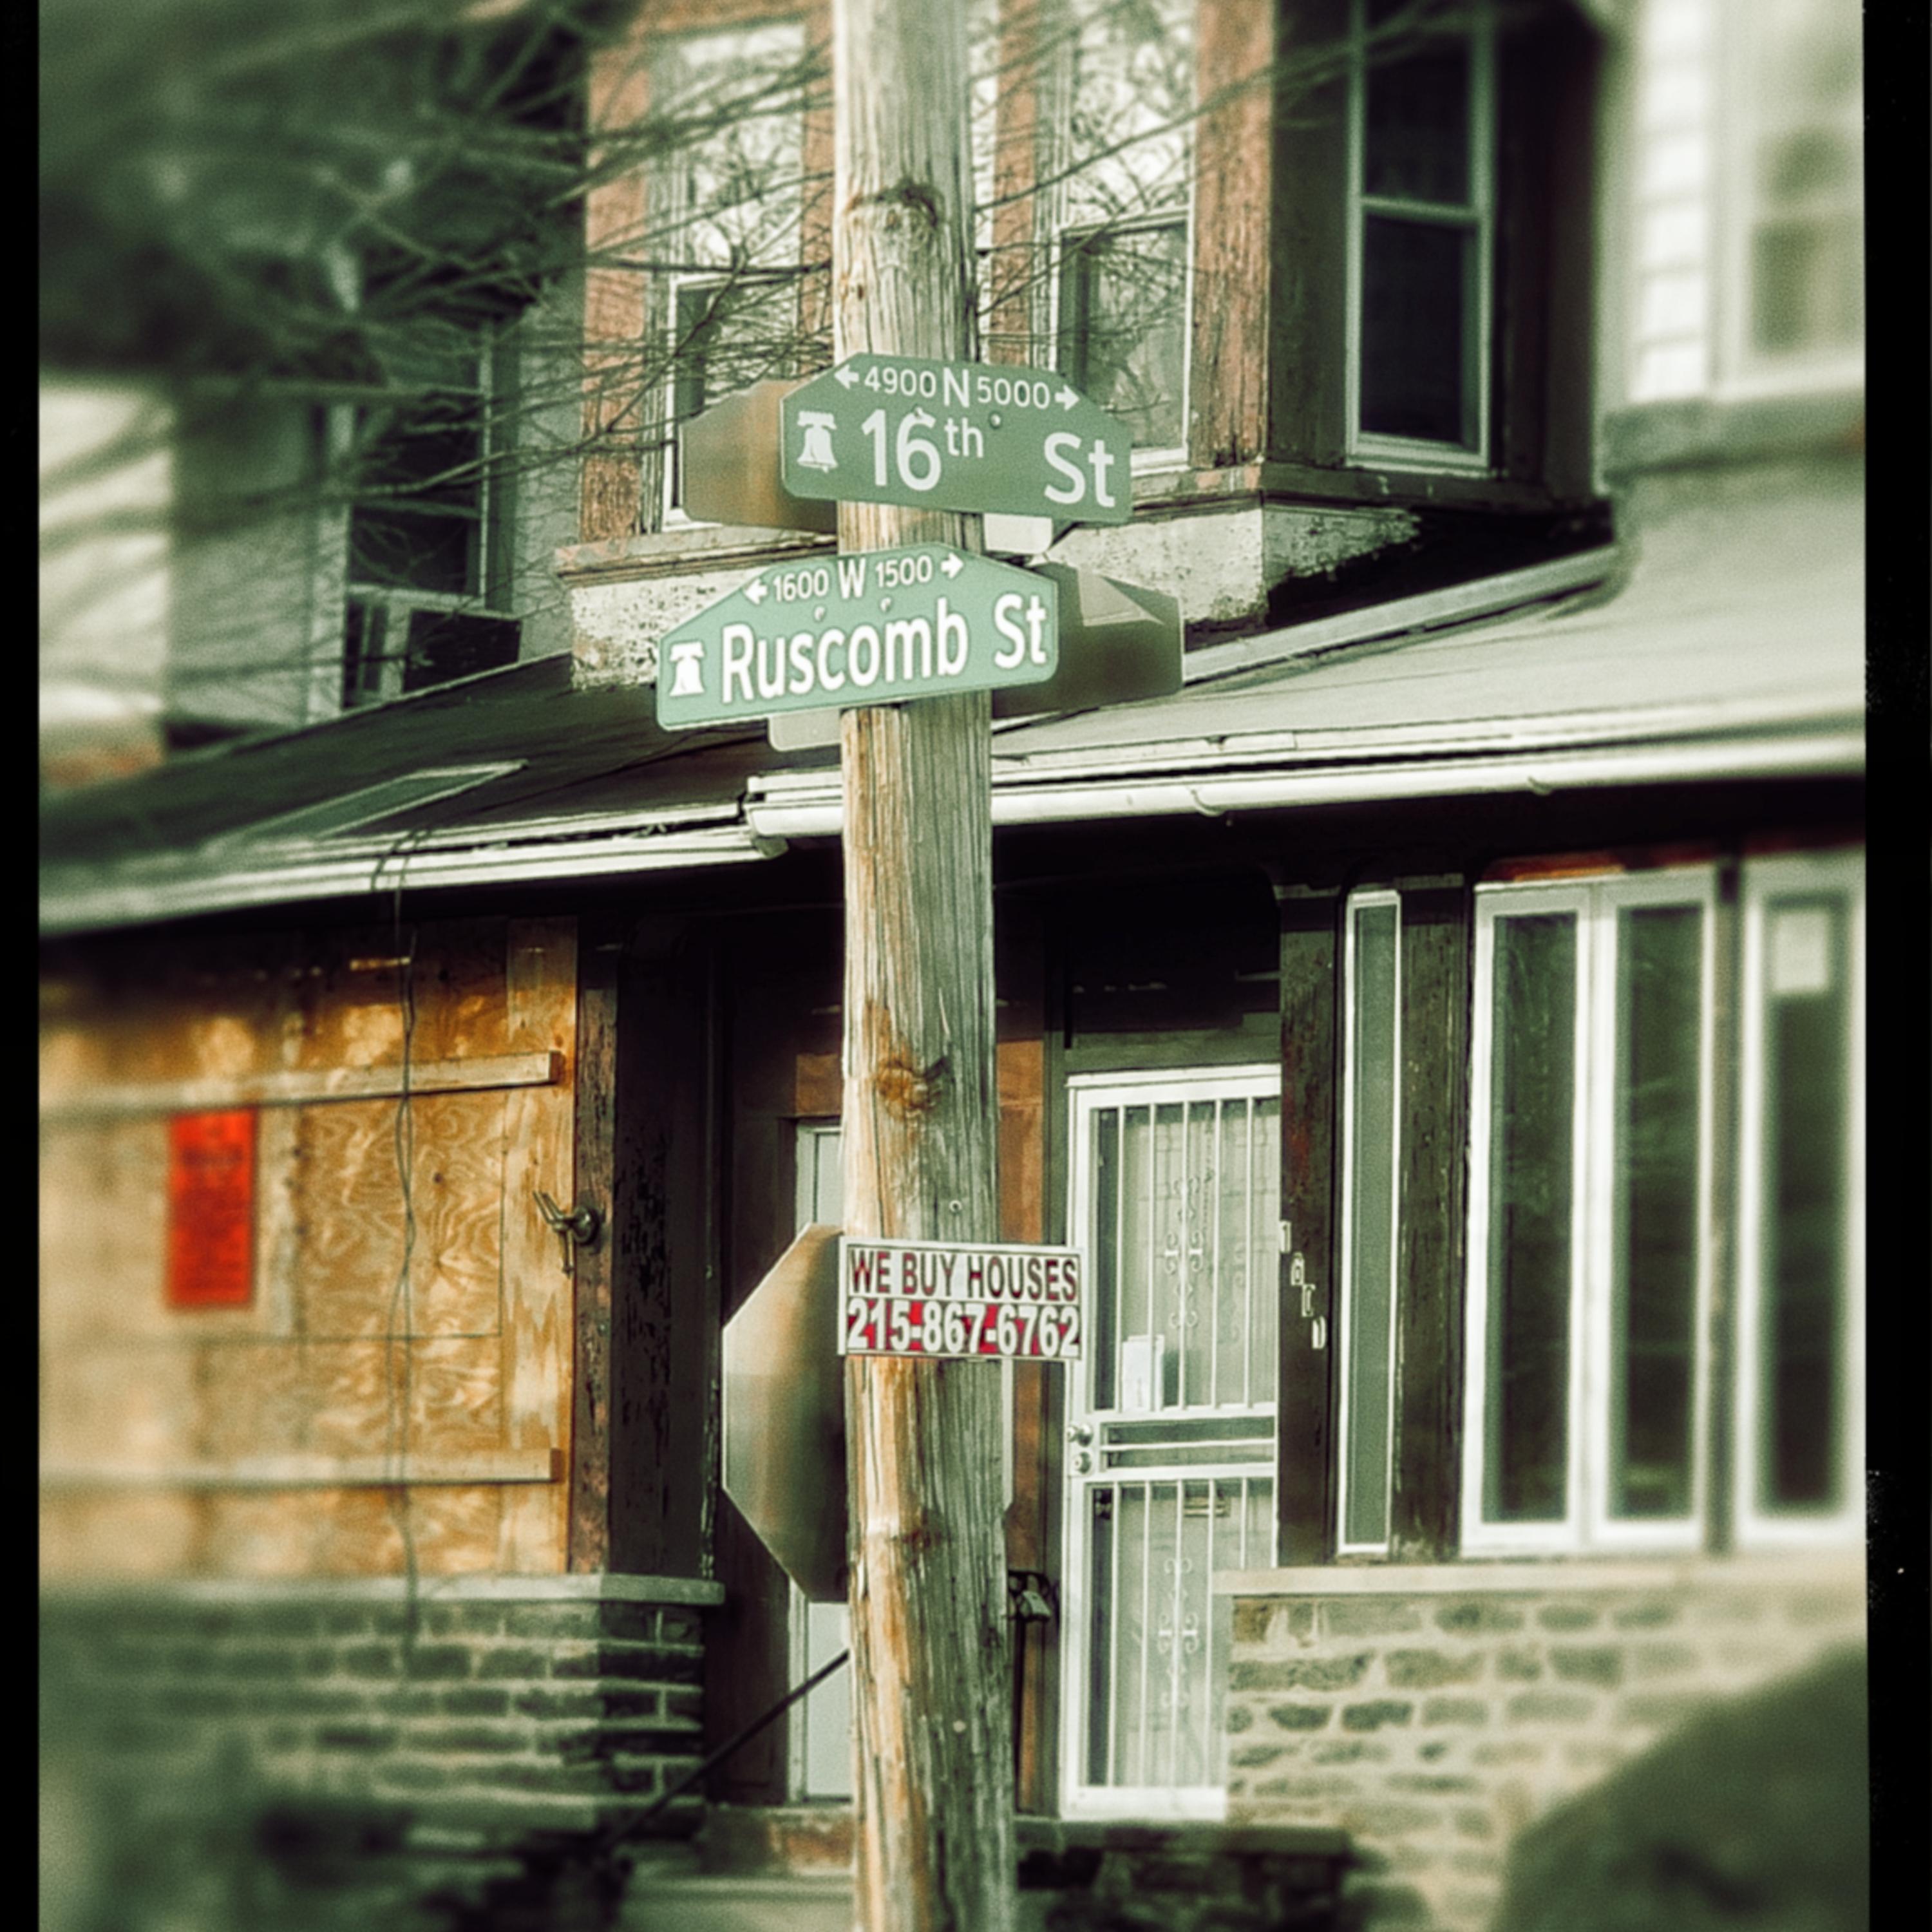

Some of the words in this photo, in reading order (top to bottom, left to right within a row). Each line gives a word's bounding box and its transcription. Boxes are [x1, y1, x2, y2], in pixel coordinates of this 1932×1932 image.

[864, 366, 936, 398] 4900
[943, 367, 970, 408] N
[977, 376, 1050, 409] 5000
[861, 409, 983, 491] 16th
[1044, 431, 1115, 507] St
[773, 568, 829, 601] 1600
[838, 558, 866, 599] W
[875, 555, 933, 589] 1500
[721, 598, 967, 703] Ruscomb
[994, 593, 1046, 669] St
[851, 1249, 891, 1293] WE
[903, 1252, 957, 1296] BUY
[967, 1255, 1077, 1302] HOUSES
[848, 1298, 1079, 1356] 215-867-6762
